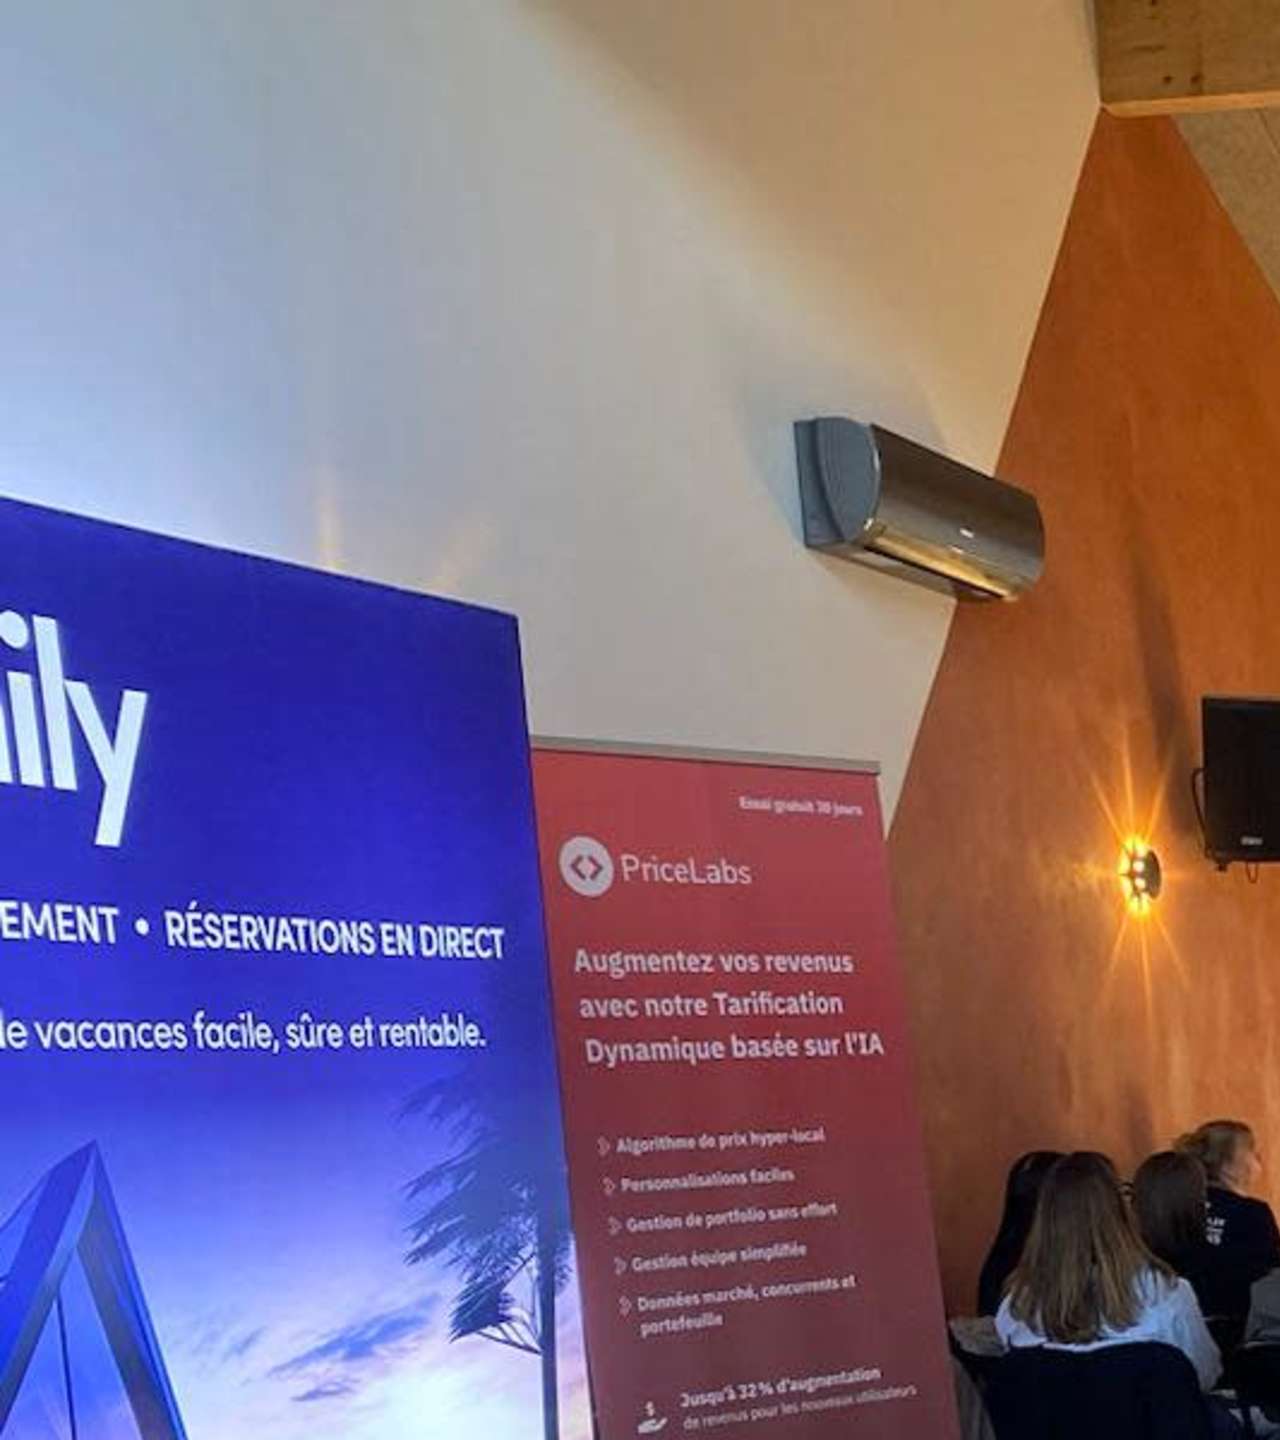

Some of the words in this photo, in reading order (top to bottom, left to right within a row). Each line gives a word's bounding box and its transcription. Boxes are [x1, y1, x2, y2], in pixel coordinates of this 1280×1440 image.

[0, 610, 148, 847] ily
[621, 853, 752, 885] PriceLabs
[0, 900, 119, 944] EMENT
[164, 900, 376, 955] RÉSERVATIONS
[379, 923, 415, 957] EN
[419, 924, 505, 960] DIRECT
[574, 949, 714, 979] Augmentez
[720, 954, 759, 973] vos
[765, 952, 854, 974] revenus
[580, 1000, 638, 1018] avec
[645, 996, 708, 1017] notre
[713, 991, 844, 1016] Tarification
[33, 1020, 188, 1050] vacances
[192, 1009, 281, 1055] facile,
[285, 1012, 344, 1049] sûre
[349, 1016, 375, 1048] et
[379, 1012, 487, 1049] rentable.
[585, 1037, 725, 1068] Dynamique
[731, 1032, 799, 1059] basée
[805, 1036, 839, 1056] sur
[845, 1031, 885, 1055] l'IA
[616, 1133, 695, 1155] Algorithme
[698, 1133, 716, 1148] de
[719, 1131, 748, 1150] prix
[751, 1127, 826, 1147] hyper-local
[621, 1170, 748, 1192] Personnalisations
[626, 1214, 682, 1233] Gestion
[686, 1211, 703, 1227] de
[705, 1207, 766, 1229] portfolio
[768, 1207, 798, 1220] sans
[632, 1253, 688, 1272] Gestion
[691, 1249, 737, 1268] équipe
[637, 1291, 699, 1312] Données
[842, 1274, 856, 1288] et
